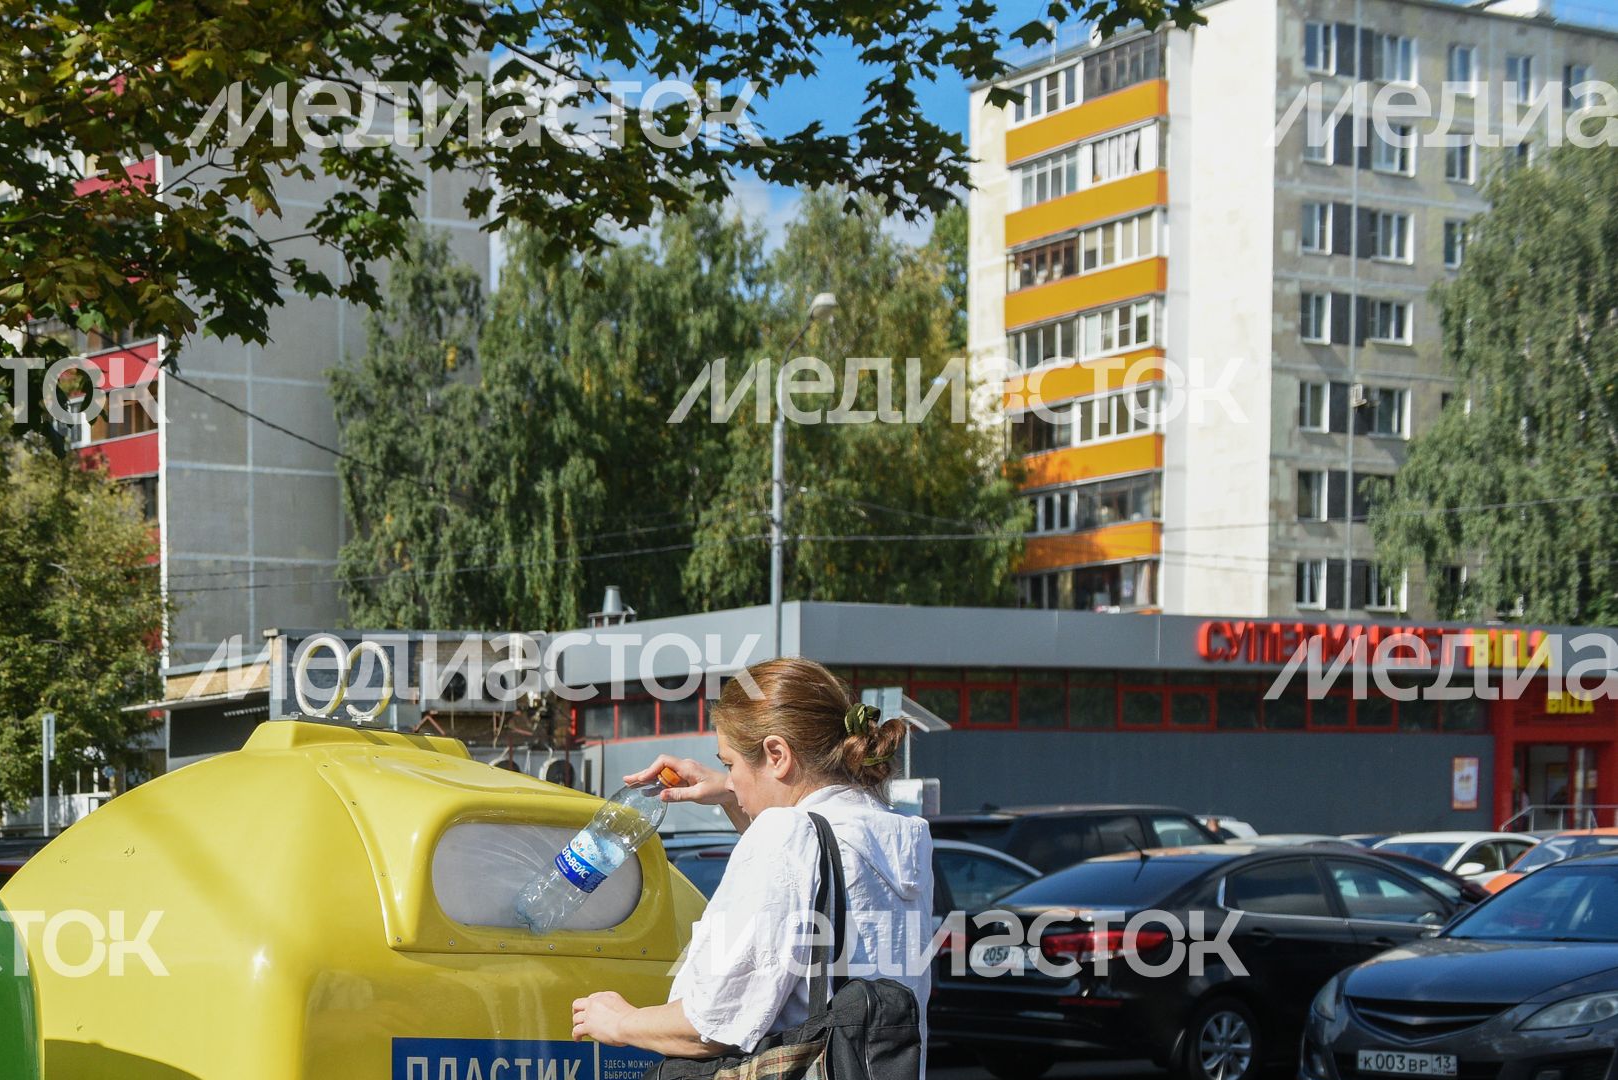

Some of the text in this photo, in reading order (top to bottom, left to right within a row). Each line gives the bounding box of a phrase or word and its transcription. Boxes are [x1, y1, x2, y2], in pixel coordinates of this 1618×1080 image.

[1546, 691, 1595, 714] BILLA
[604, 1059, 654, 1070] ЗДЕСЬ МОЖНО
